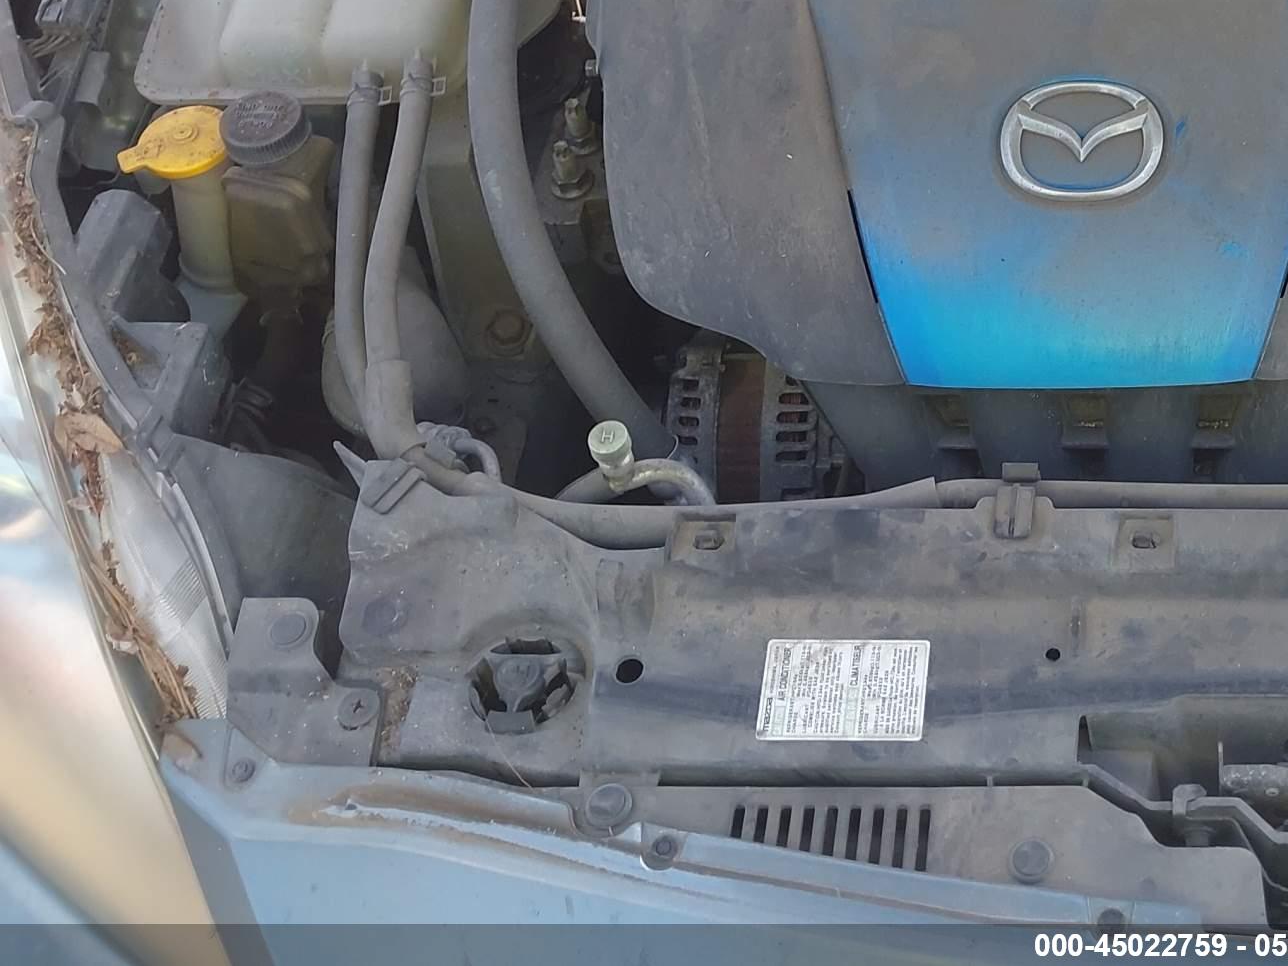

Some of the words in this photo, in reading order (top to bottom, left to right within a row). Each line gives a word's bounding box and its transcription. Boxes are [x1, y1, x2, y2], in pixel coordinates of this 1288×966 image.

[600, 428, 614, 443] H
[779, 648, 791, 690] CONDITIONER
[850, 645, 863, 686] CLIMATISEUR
[778, 690, 786, 702] AIR
[762, 697, 773, 732] mazda
